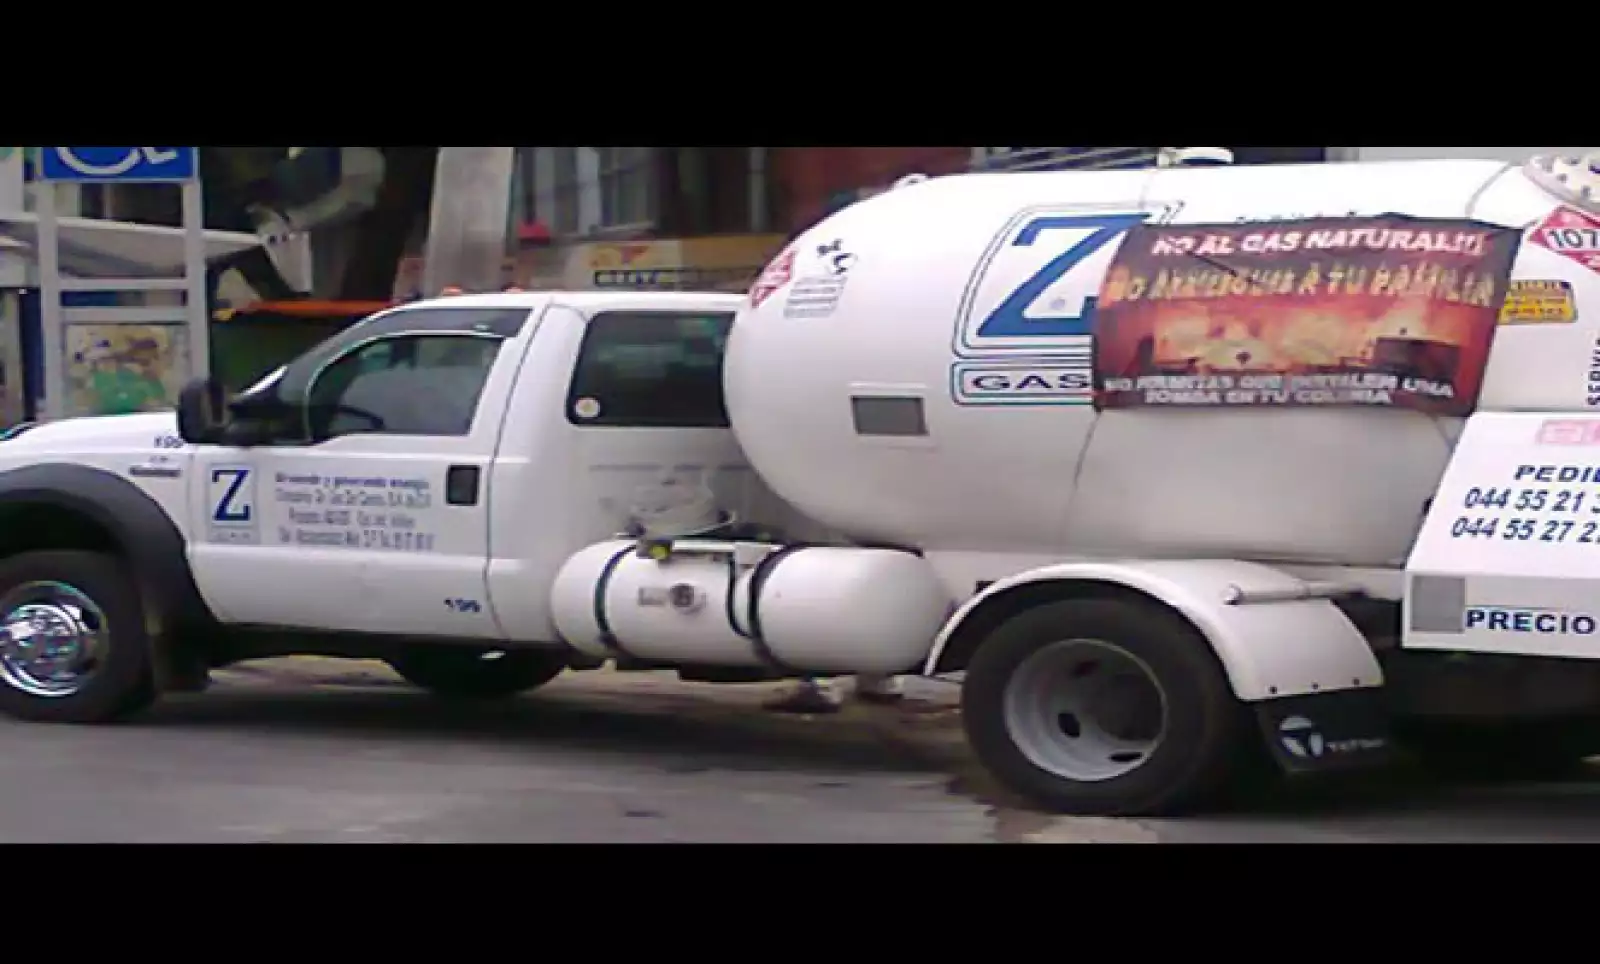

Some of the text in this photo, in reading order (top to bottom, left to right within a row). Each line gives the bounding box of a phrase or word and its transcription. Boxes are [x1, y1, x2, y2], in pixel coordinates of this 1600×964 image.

[1152, 234, 1196, 256] NO
[1195, 234, 1235, 254] AL
[1241, 230, 1302, 253] GAS
[977, 212, 1155, 336] Z
[1327, 261, 1367, 295] TU
[972, 374, 1090, 391] GAS
[1402, 377, 1454, 398] UNA
[211, 469, 250, 521] Z
[1464, 486, 1512, 509] 044
[1515, 489, 1549, 512] 55
[1551, 489, 1585, 513] 21
[1451, 516, 1500, 538] 044
[1503, 518, 1538, 541] 55
[1539, 520, 1575, 543] 27
[1466, 609, 1596, 635] PRECIO
